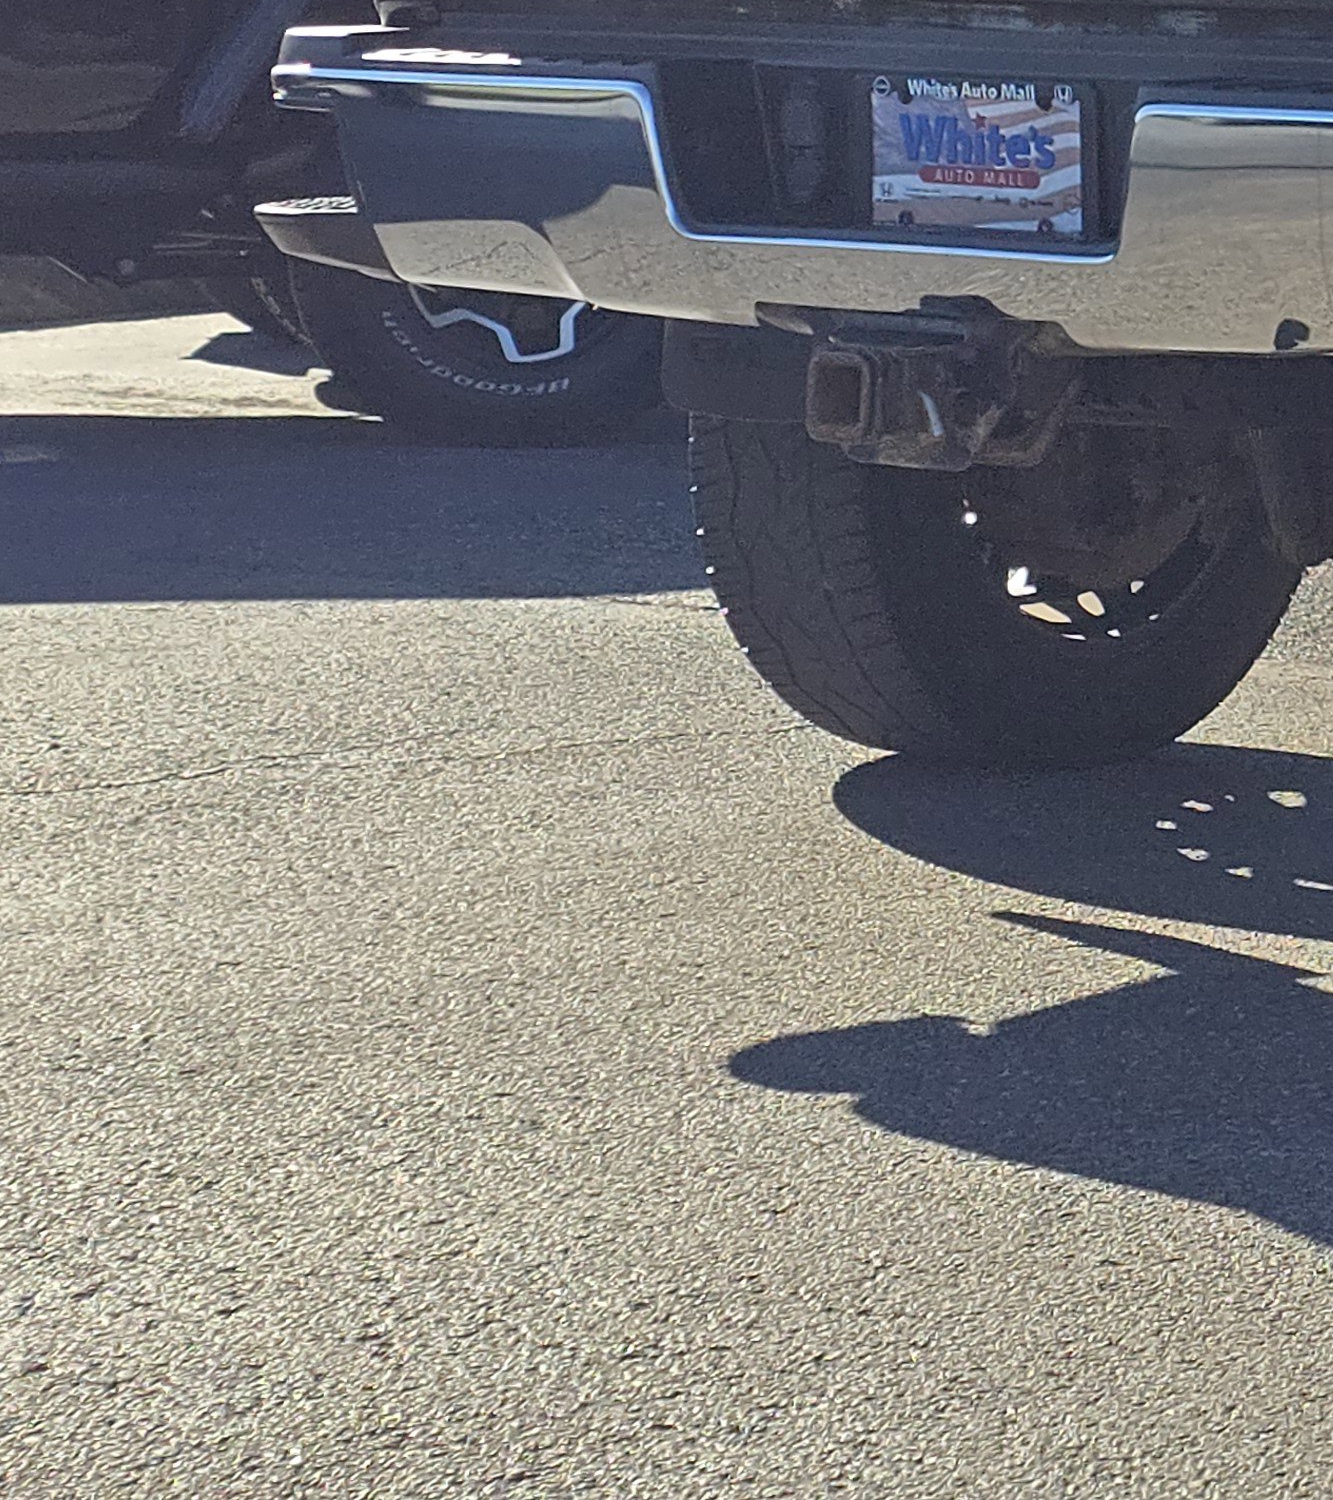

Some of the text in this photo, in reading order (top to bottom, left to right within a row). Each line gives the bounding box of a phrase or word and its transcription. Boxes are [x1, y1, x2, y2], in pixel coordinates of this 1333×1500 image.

[908, 78, 1036, 100] White's Auto Mall
[899, 112, 1056, 169] White's
[934, 169, 1025, 187] AUTO MALL
